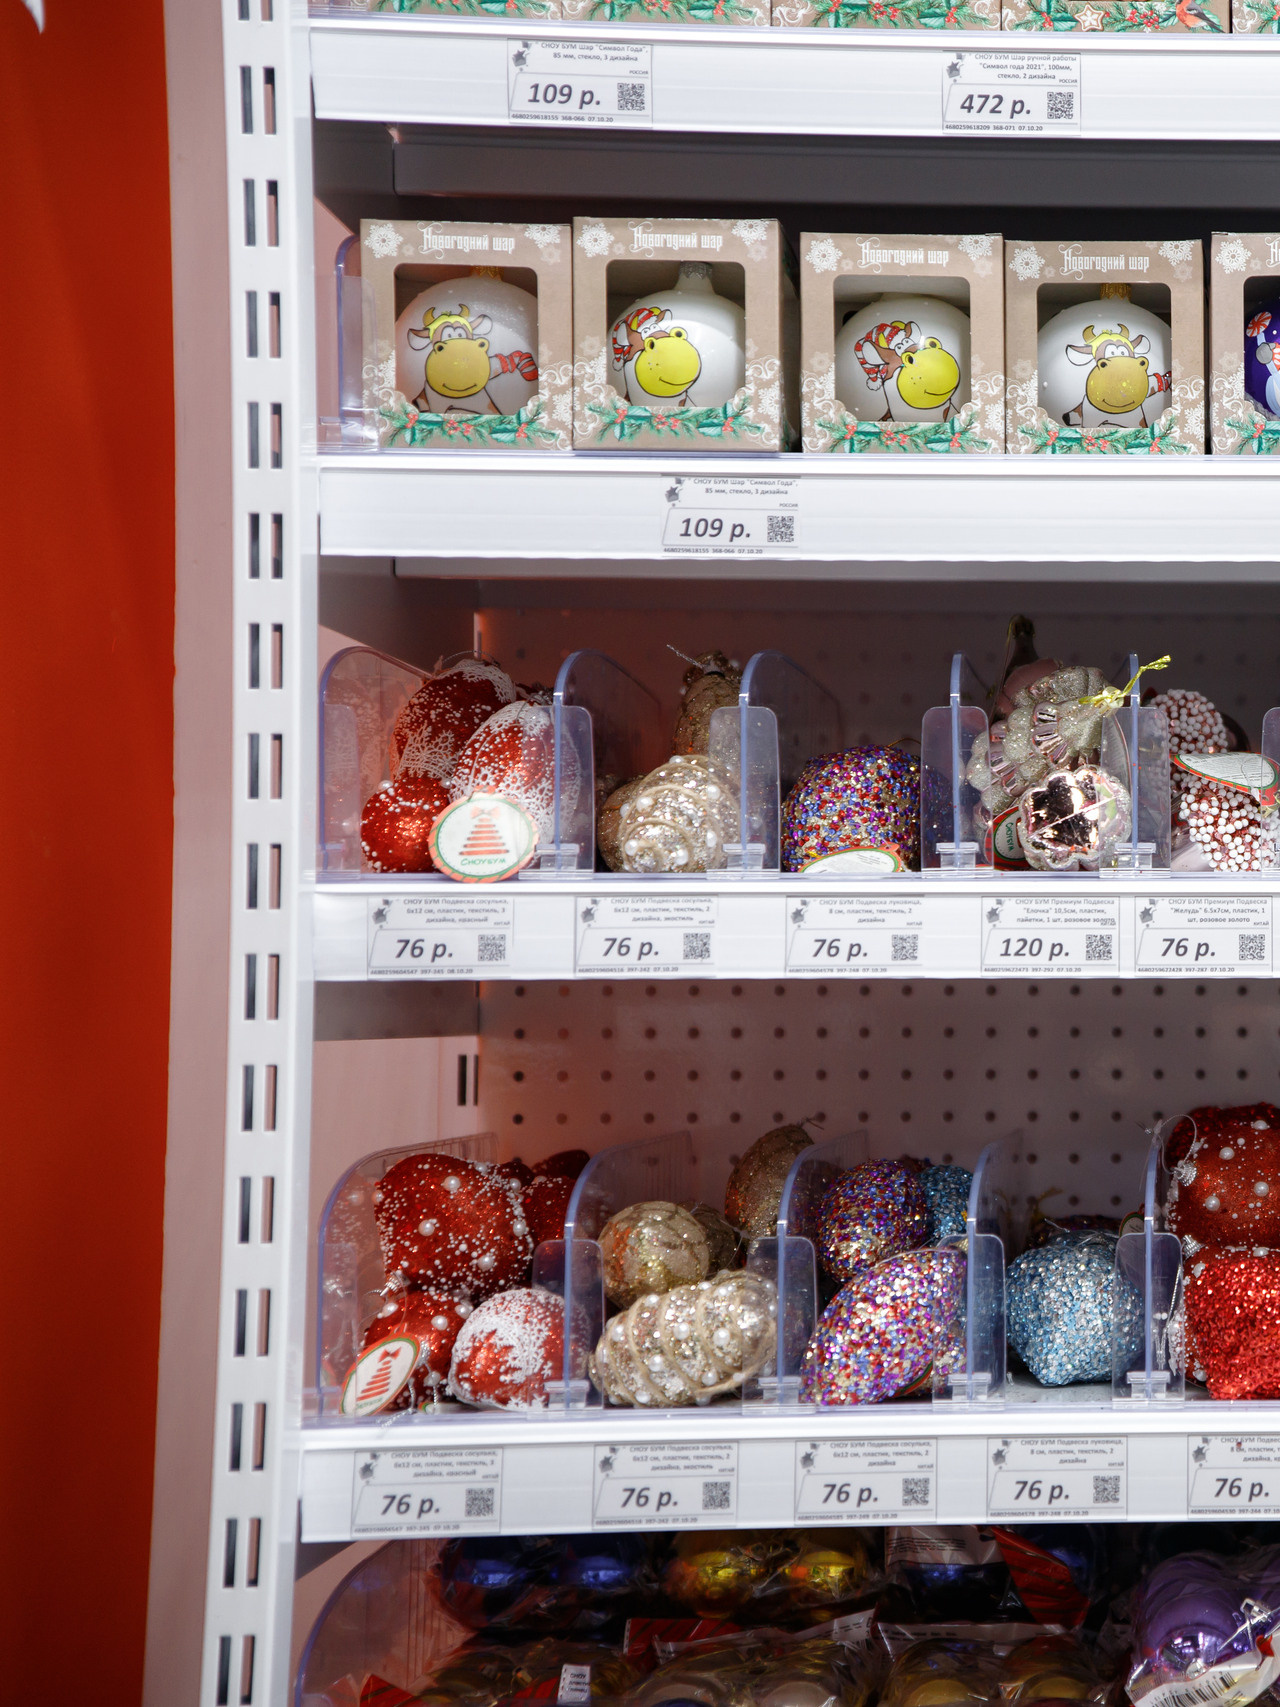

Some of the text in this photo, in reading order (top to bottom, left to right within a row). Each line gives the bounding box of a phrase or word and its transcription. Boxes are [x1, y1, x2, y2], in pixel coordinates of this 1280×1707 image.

[1052, 54, 1076, 62] работы
[528, 83, 600, 109] 109 р.
[960, 94, 1030, 119] 472 р.
[417, 221, 515, 259] Новогодний шар
[628, 221, 722, 258] Новогодний шар
[856, 237, 949, 274] Новогодний шар
[1060, 243, 1149, 276] Новогодний шар
[680, 518, 750, 542] 109 р.
[396, 939, 452, 962] 76 р.
[603, 937, 658, 960] 76 р.
[813, 939, 867, 961] 76 р.
[1000, 938, 1069, 961] 120 р.
[1162, 938, 1215, 961] 76 р.
[622, 1487, 677, 1511] 76 р.
[823, 1483, 878, 1507] 76 р.
[1015, 1480, 1069, 1504] 76 р.
[1215, 1478, 1269, 1502] 76 р.
[382, 1494, 439, 1519] 76 р.
